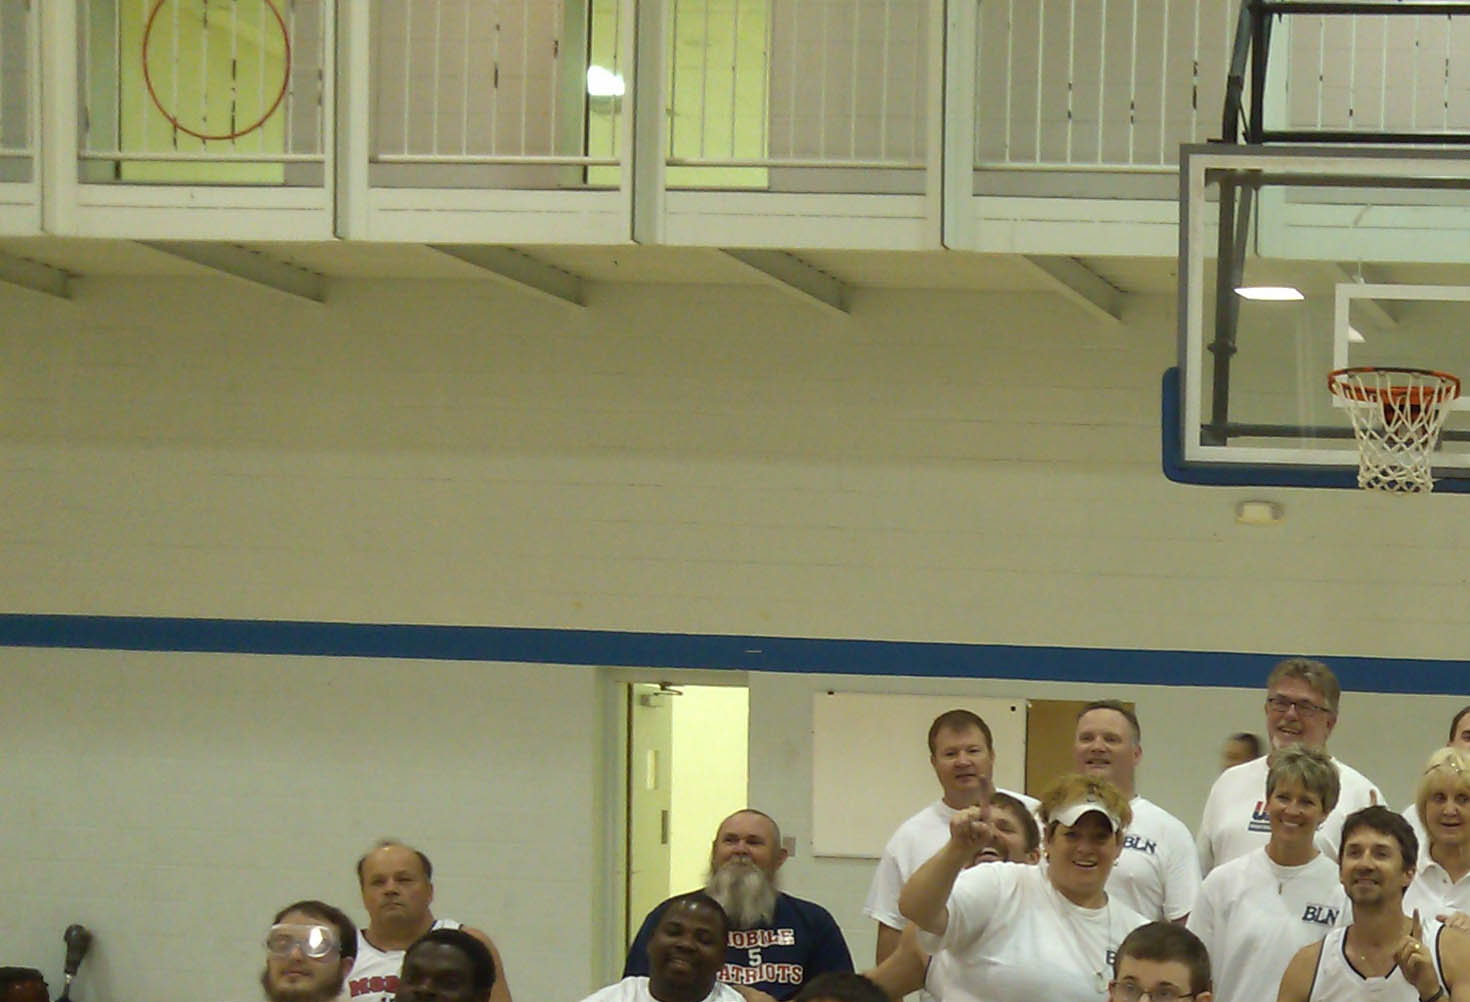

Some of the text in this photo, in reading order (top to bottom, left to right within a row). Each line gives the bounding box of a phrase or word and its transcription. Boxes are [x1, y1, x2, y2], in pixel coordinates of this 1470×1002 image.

[1123, 835, 1157, 855] BLN
[1302, 905, 1340, 926] BLN
[727, 928, 796, 949] OBILE
[748, 947, 763, 967] 5
[716, 963, 804, 985] ATRIOTS
[349, 974, 400, 998] MOB
